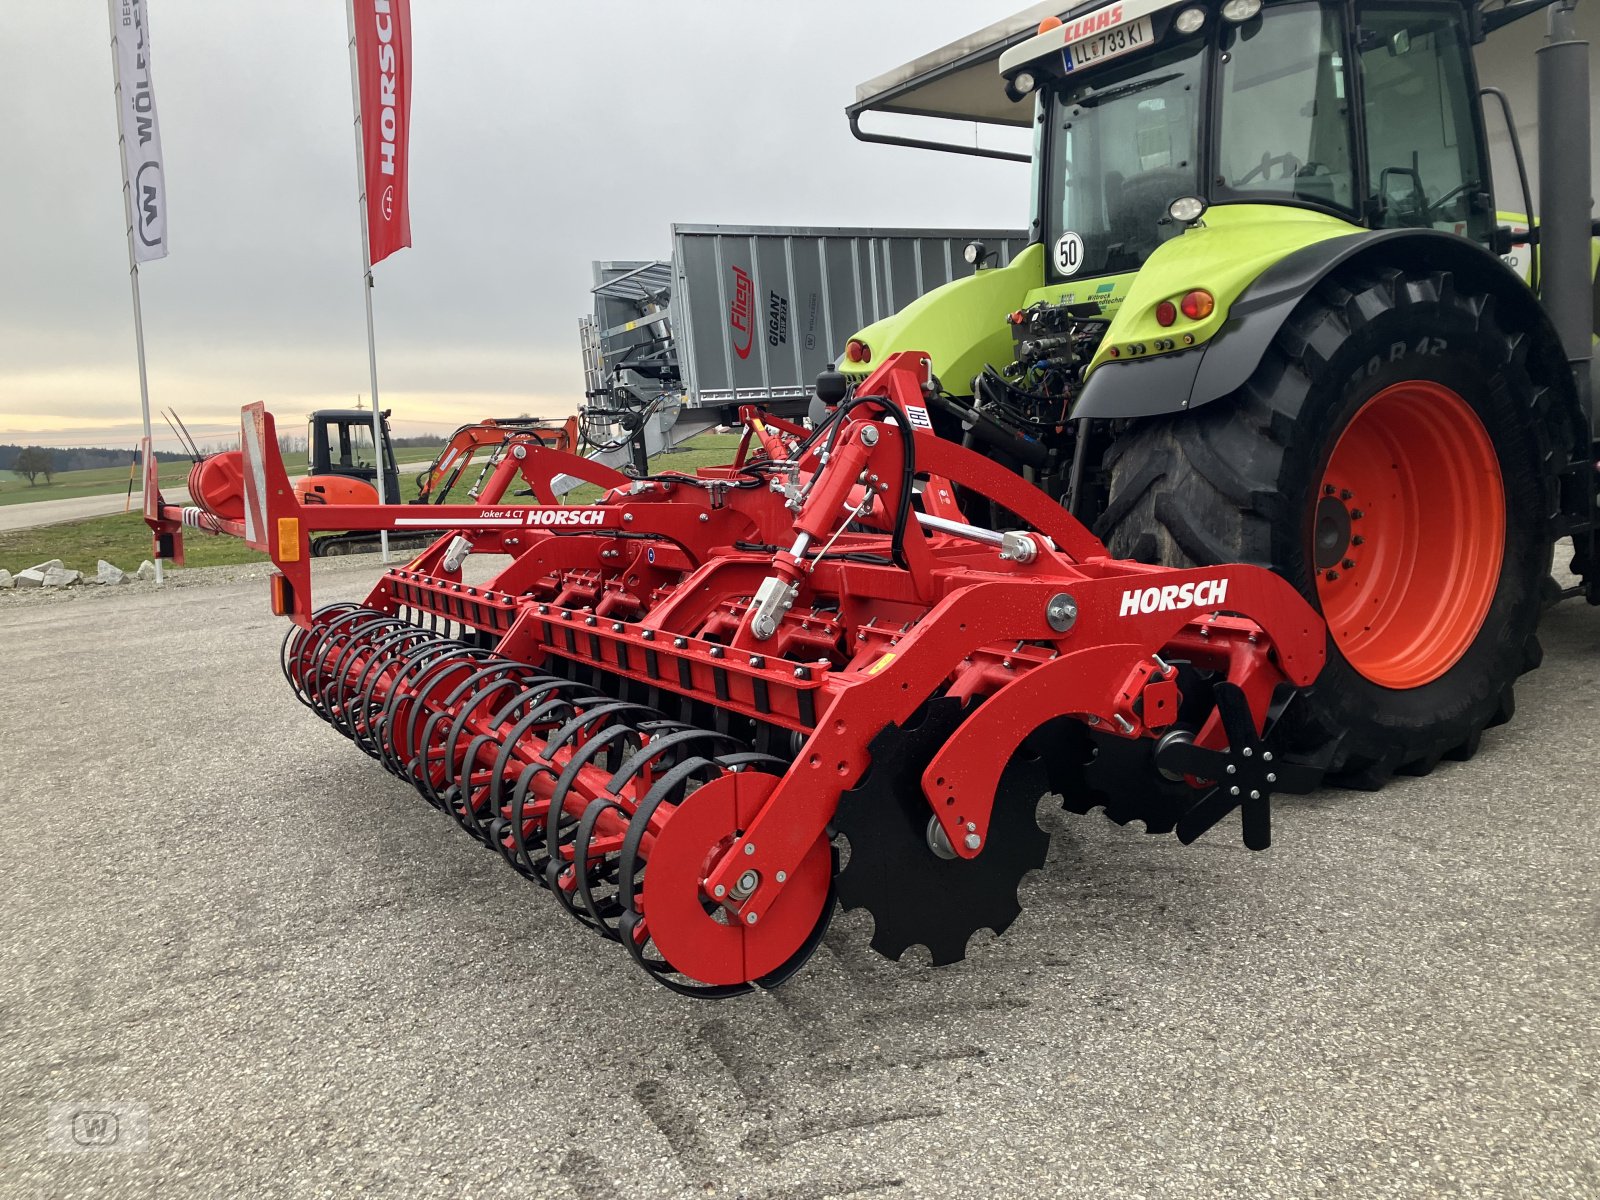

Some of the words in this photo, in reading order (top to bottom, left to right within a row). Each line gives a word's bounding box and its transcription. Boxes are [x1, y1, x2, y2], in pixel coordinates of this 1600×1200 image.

[1064, 5, 1123, 43] CLAAS
[1075, 44, 1091, 64] LL
[1099, 30, 1126, 55] 733
[1128, 22, 1143, 45] KI
[1060, 240, 1077, 267] 50
[731, 265, 751, 332] Fliegl
[768, 290, 780, 347] GIGANT
[480, 510, 502, 518] Joker
[505, 510, 511, 518] 4
[512, 510, 524, 518] CT
[526, 510, 605, 525] HORSCH
[1119, 578, 1229, 617] HORSCH
